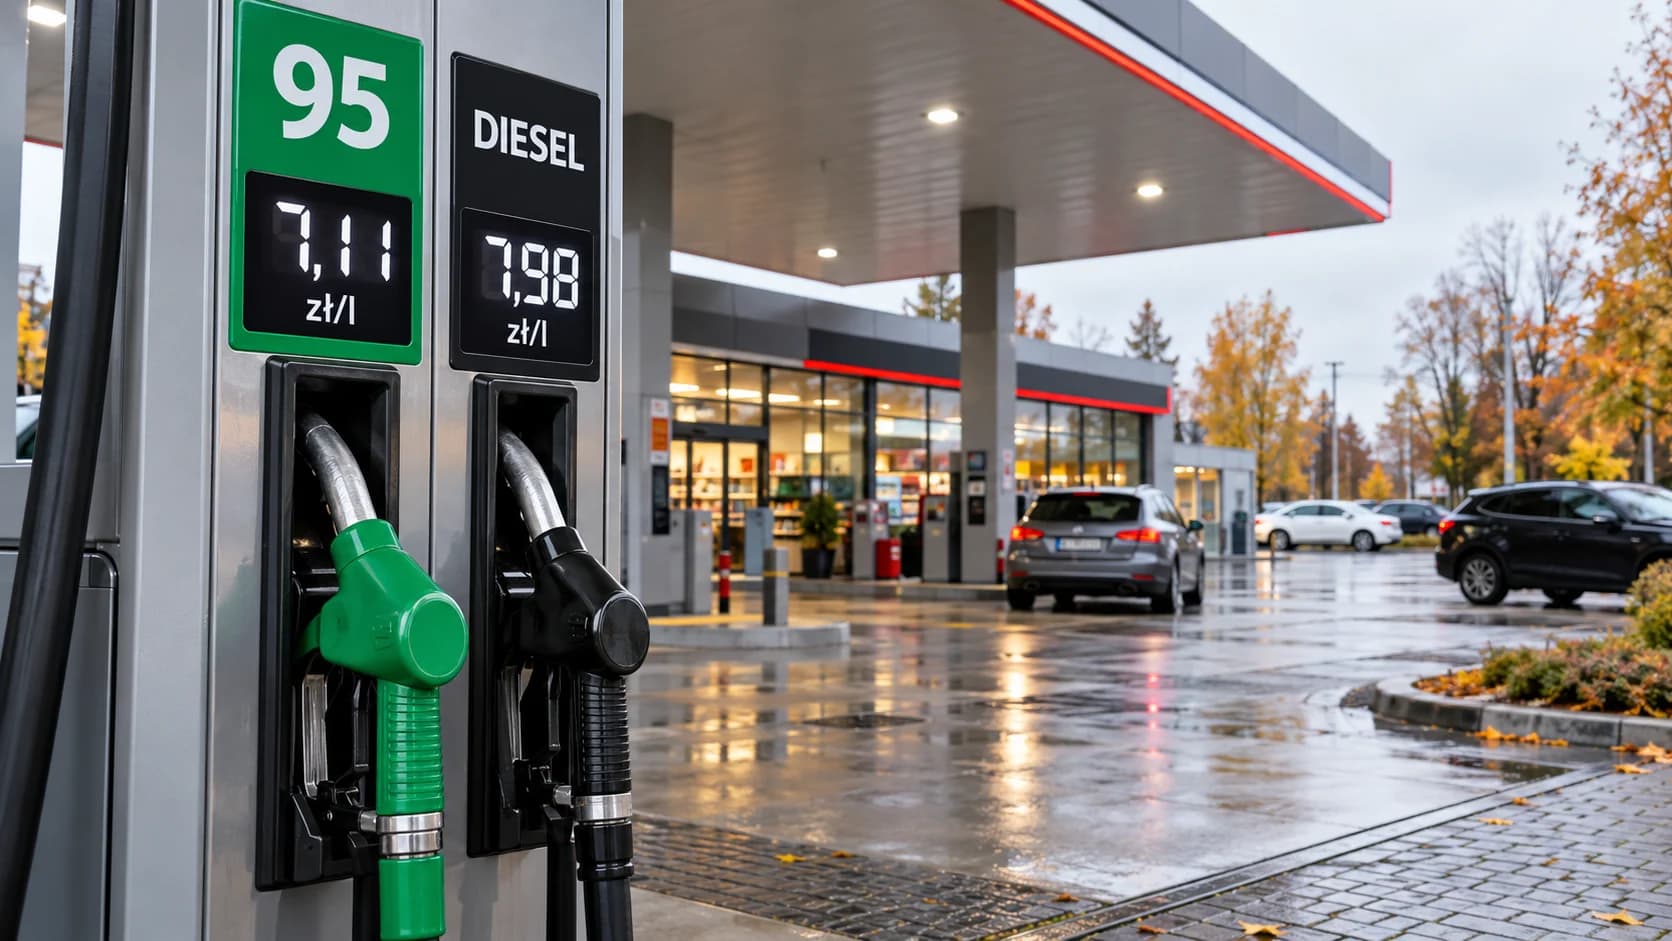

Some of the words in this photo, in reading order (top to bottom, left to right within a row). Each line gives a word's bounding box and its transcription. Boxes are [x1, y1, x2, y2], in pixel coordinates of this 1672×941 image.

[273, 43, 390, 149] 95
[474, 108, 585, 172] DIESEL
[275, 201, 392, 282] 7,11
[484, 234, 579, 310] 7,98
[305, 292, 355, 326] zł/l
[507, 317, 547, 347] zł/l
